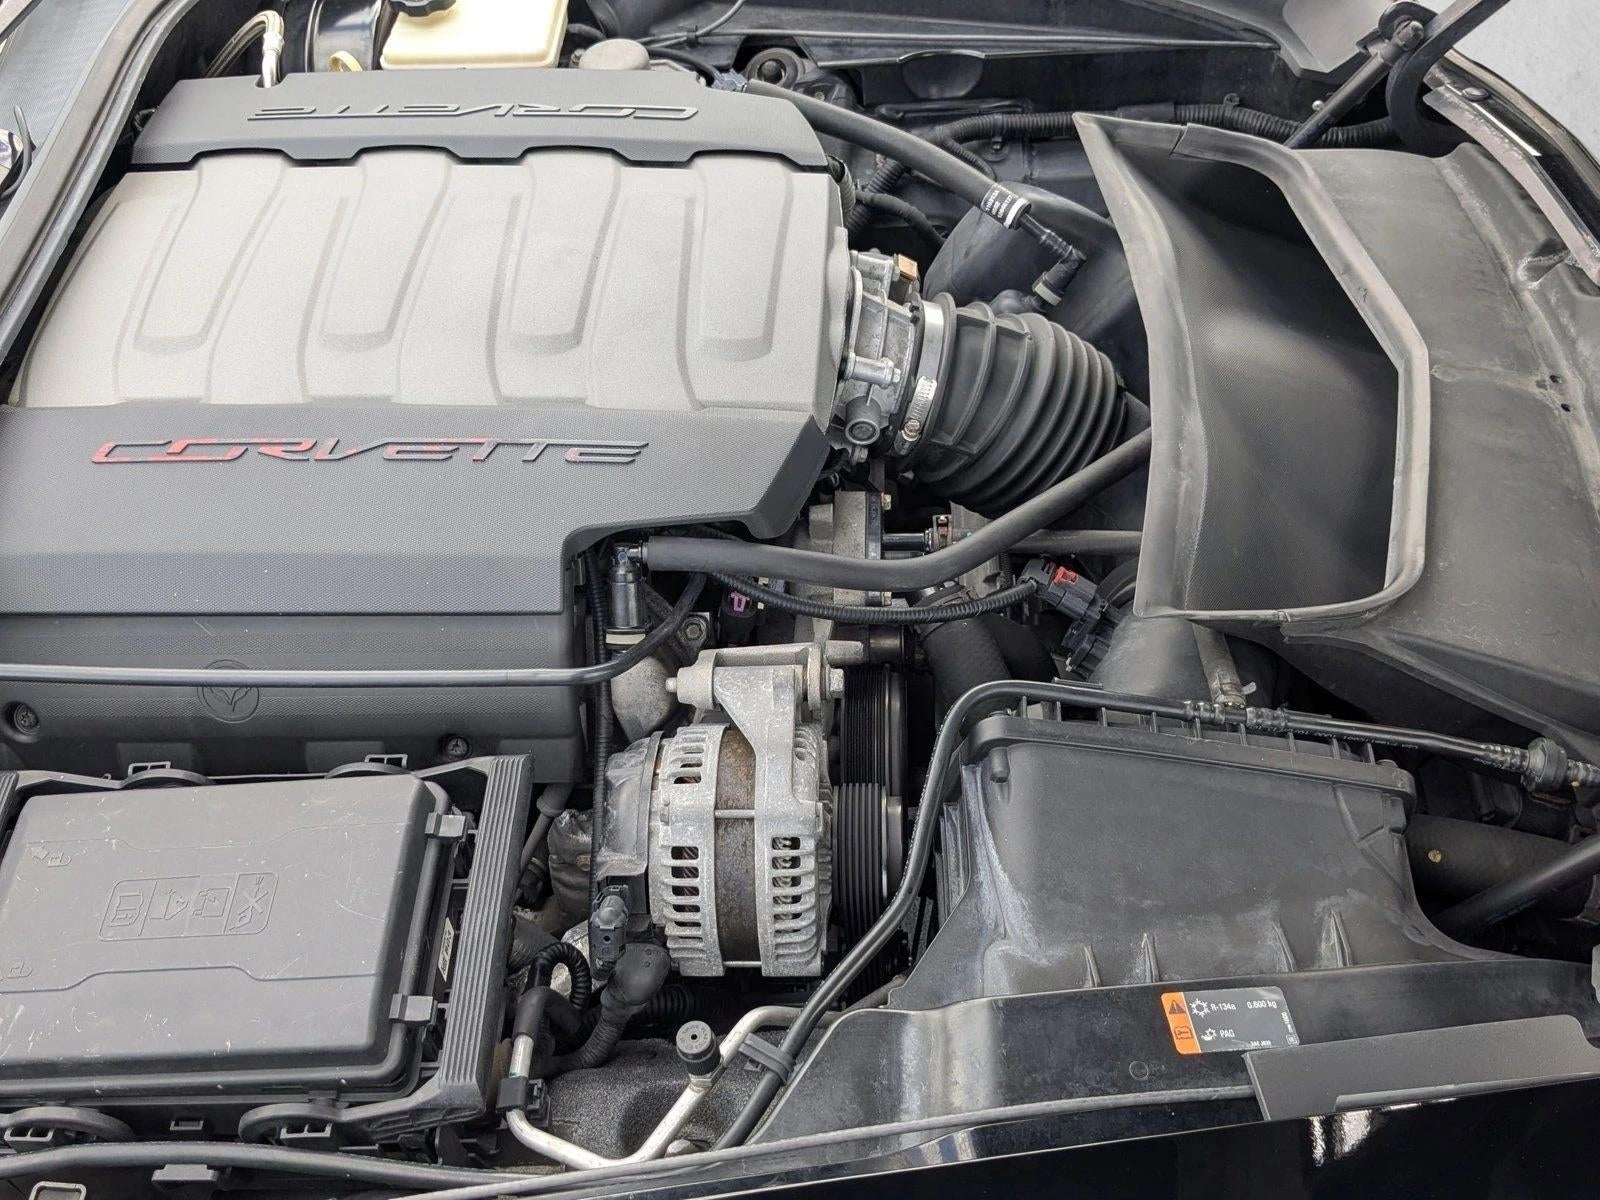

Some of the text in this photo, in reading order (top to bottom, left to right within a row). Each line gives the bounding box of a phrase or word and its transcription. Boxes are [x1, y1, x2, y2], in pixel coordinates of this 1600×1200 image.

[247, 103, 698, 120] CORVETTE
[92, 438, 649, 464] CORVETTE
[1210, 1003, 1237, 1012] R-134a
[1267, 1000, 1278, 1009] kg
[1219, 1029, 1235, 1038] PAG
